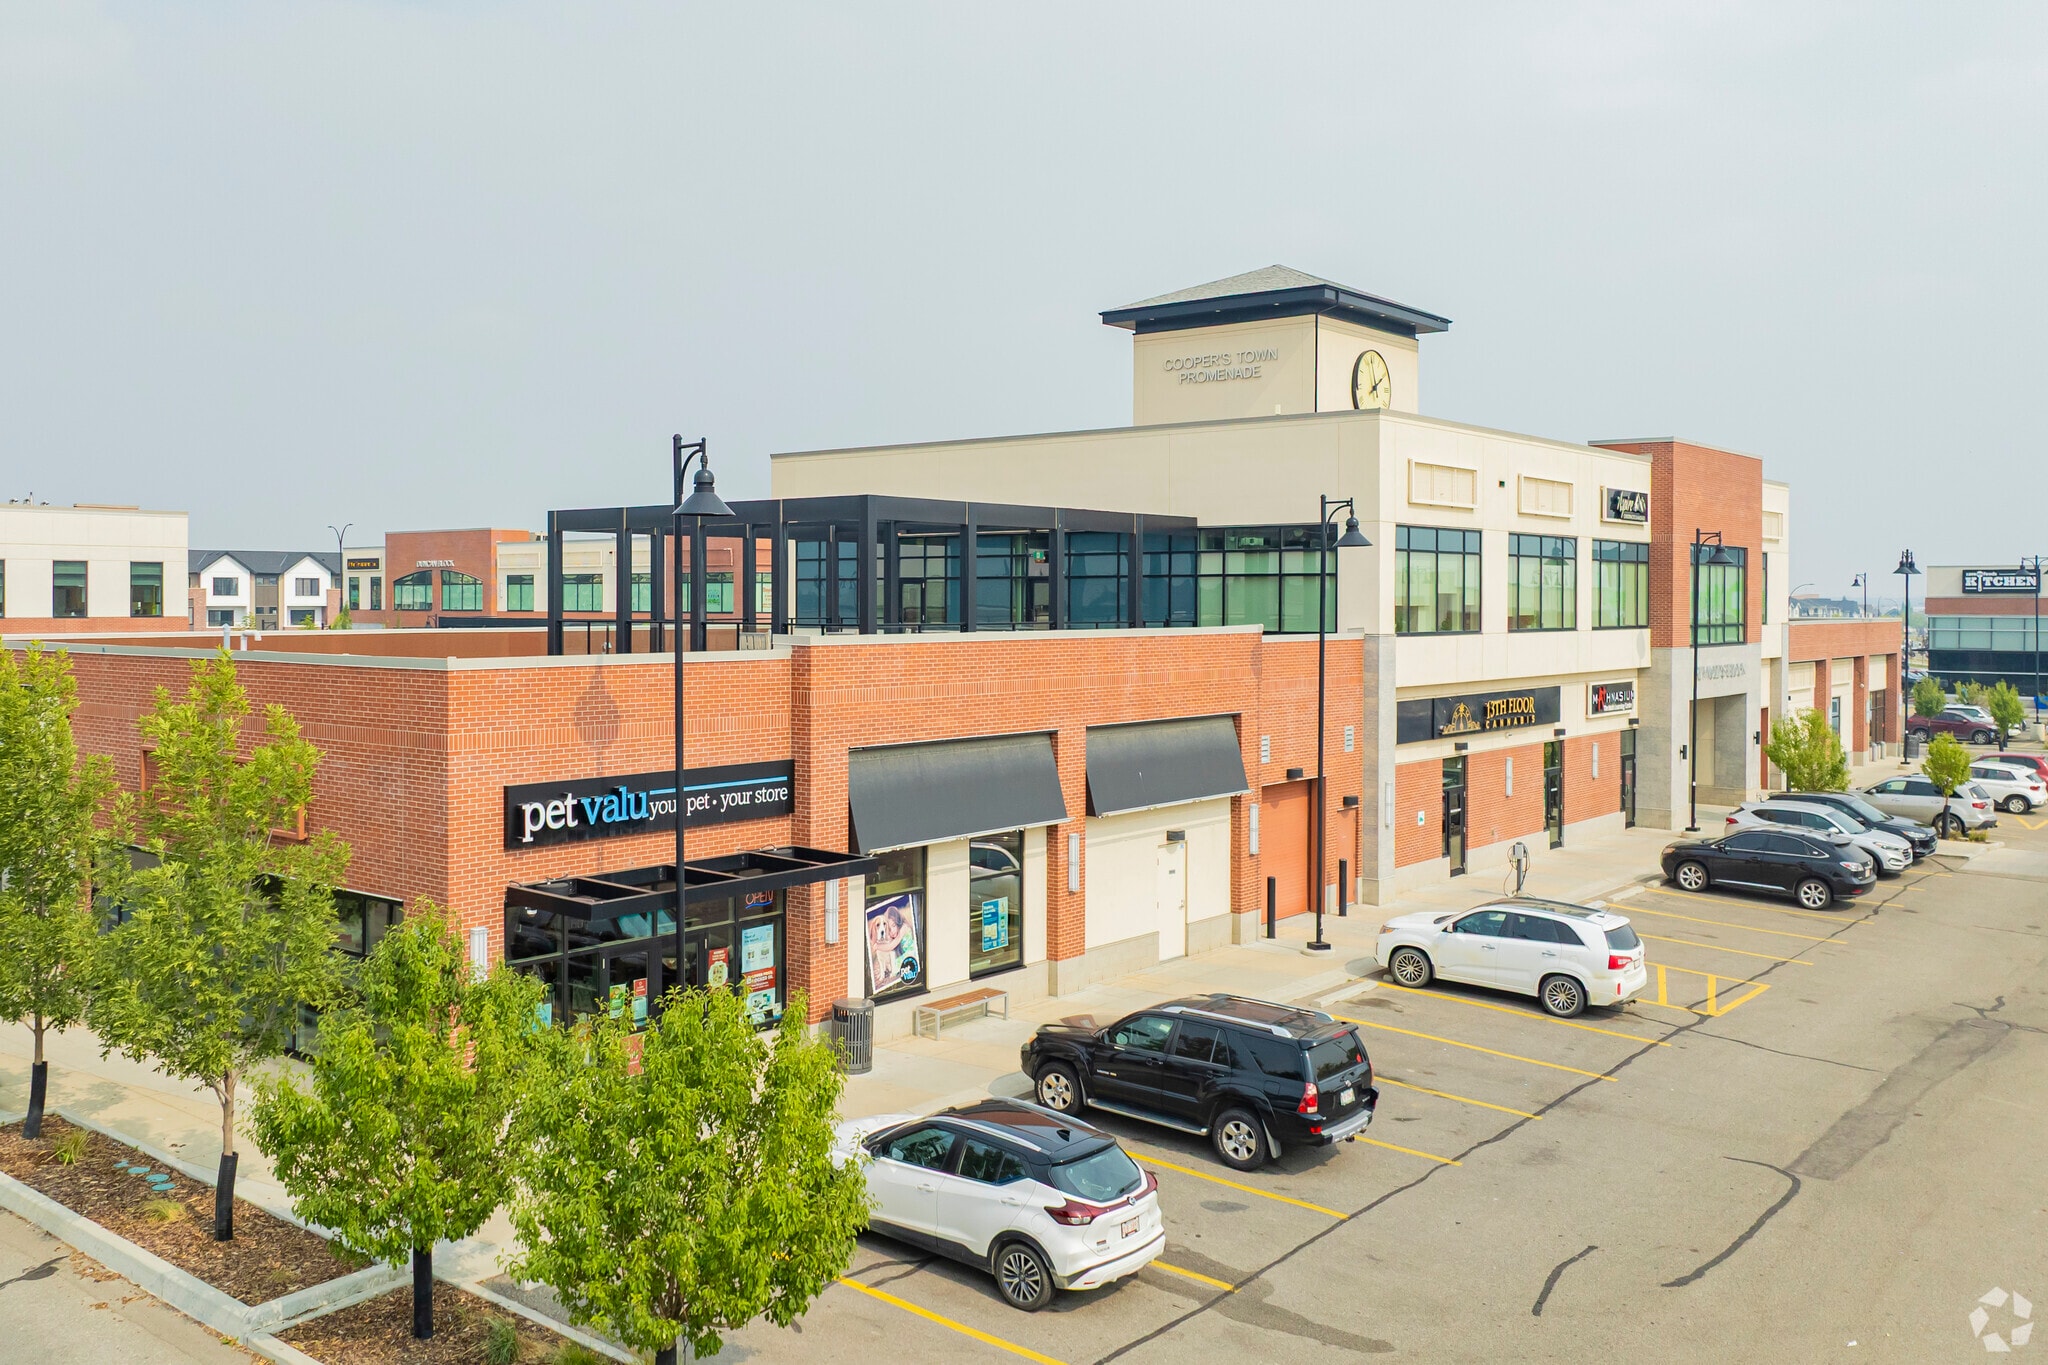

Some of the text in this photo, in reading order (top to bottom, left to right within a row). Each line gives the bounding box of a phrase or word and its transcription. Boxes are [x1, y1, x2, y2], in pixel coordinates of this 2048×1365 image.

[1163, 348, 1279, 372] COOPER'S TOWN
[1179, 365, 1262, 385] PROMENADE
[1486, 696, 1536, 720] 13TH FLOOR
[1485, 715, 1536, 729] CANNABIS
[520, 785, 649, 843] pet valu
[649, 786, 788, 821] you pet your store
[745, 889, 774, 905] OPEN
